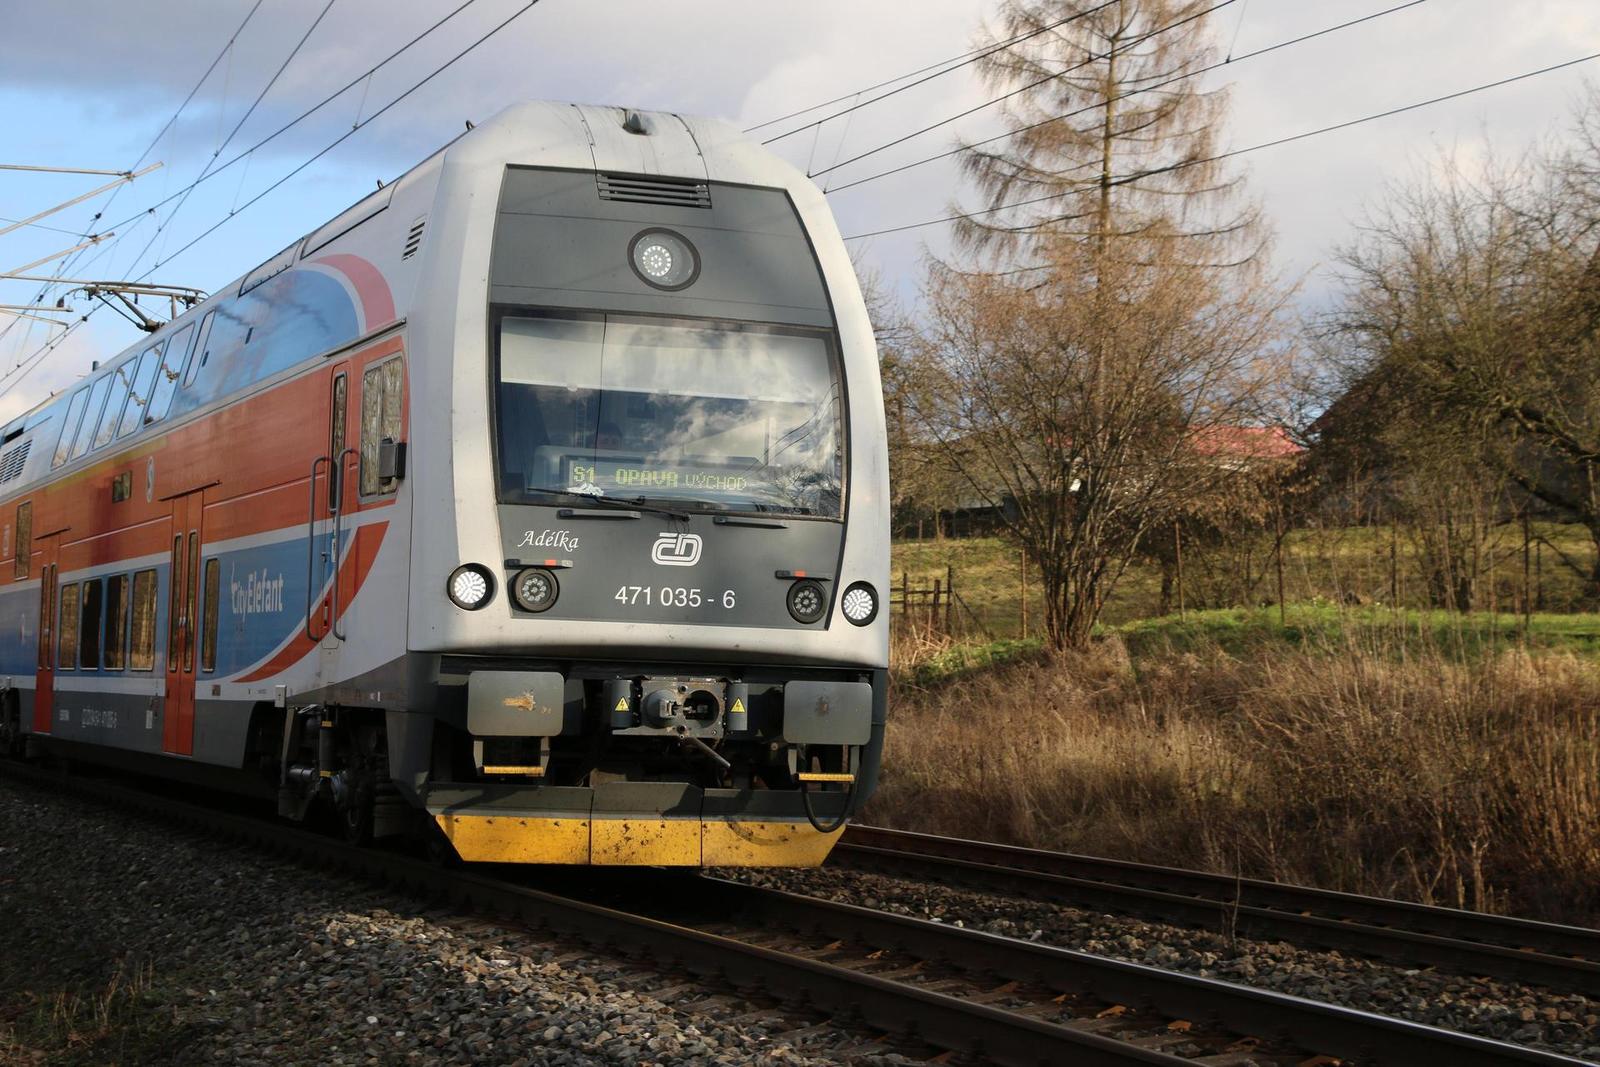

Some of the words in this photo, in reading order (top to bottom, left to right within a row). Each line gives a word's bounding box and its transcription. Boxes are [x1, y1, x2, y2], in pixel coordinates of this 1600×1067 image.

[573, 466, 595, 484] S1
[615, 468, 679, 488] OPAVA
[517, 528, 580, 553] Adélka
[230, 567, 284, 622] CityElefant
[614, 586, 652, 606] 471
[660, 587, 702, 608] 035
[722, 590, 737, 610] 6
